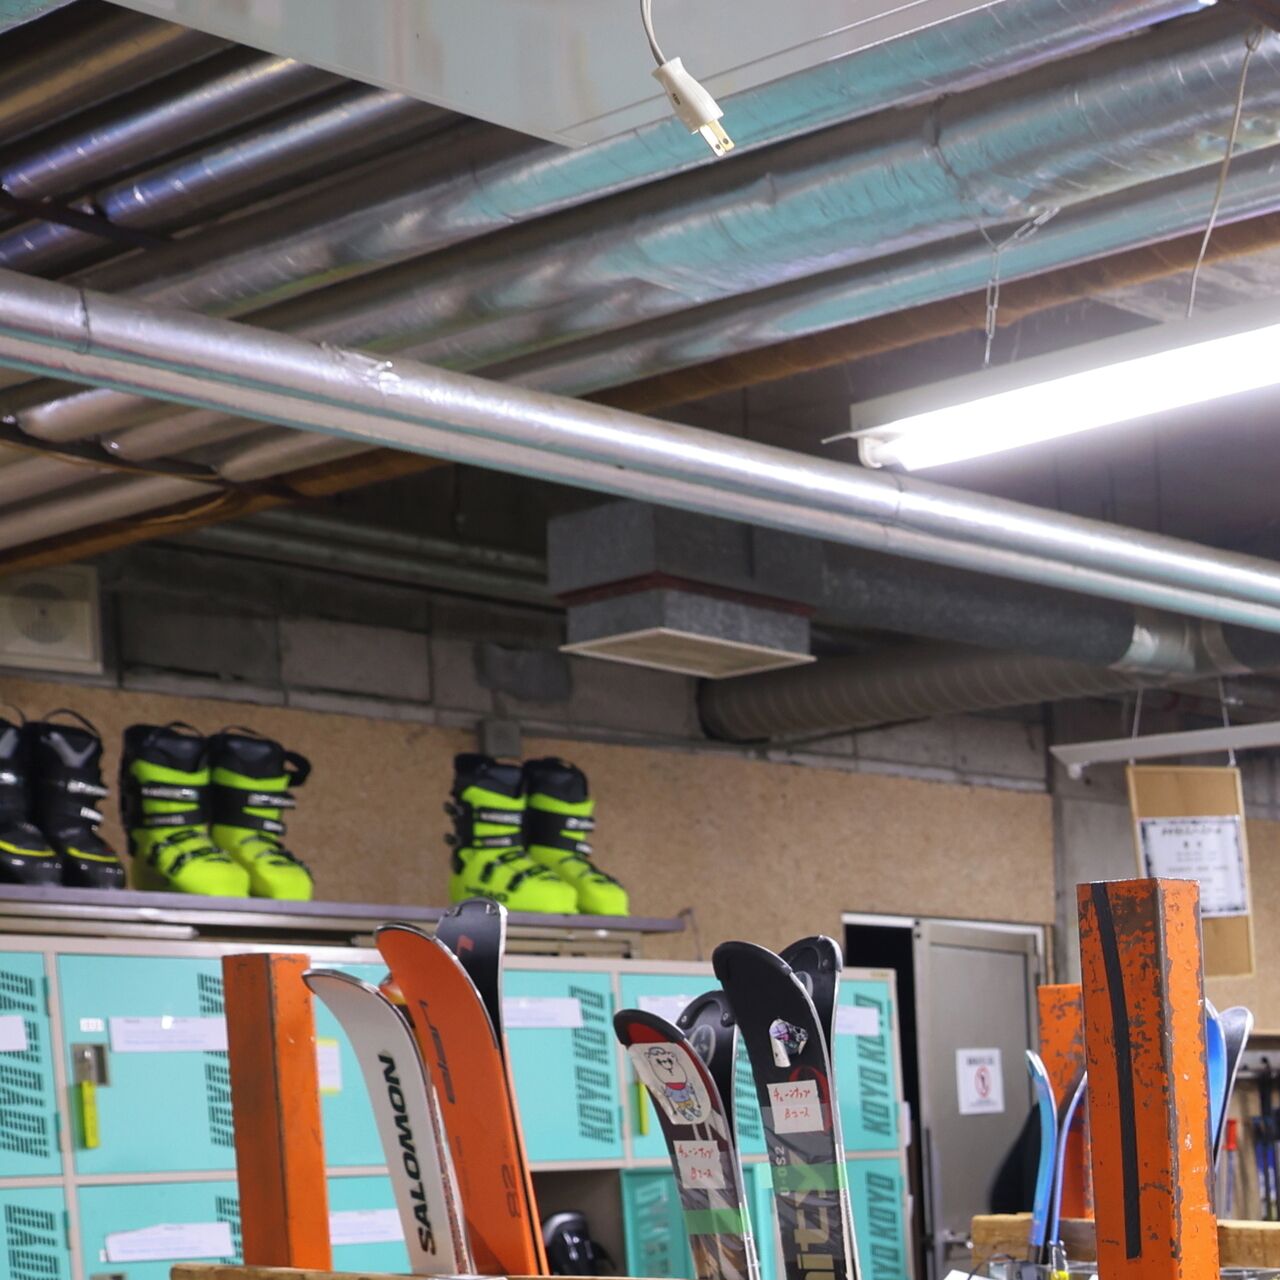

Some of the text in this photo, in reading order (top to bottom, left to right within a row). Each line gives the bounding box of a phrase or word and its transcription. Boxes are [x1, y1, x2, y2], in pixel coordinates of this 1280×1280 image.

[858, 1066, 892, 1137] KOYO
[378, 1053, 436, 1256] SALOMON
[866, 1171, 895, 1243] KOYO
